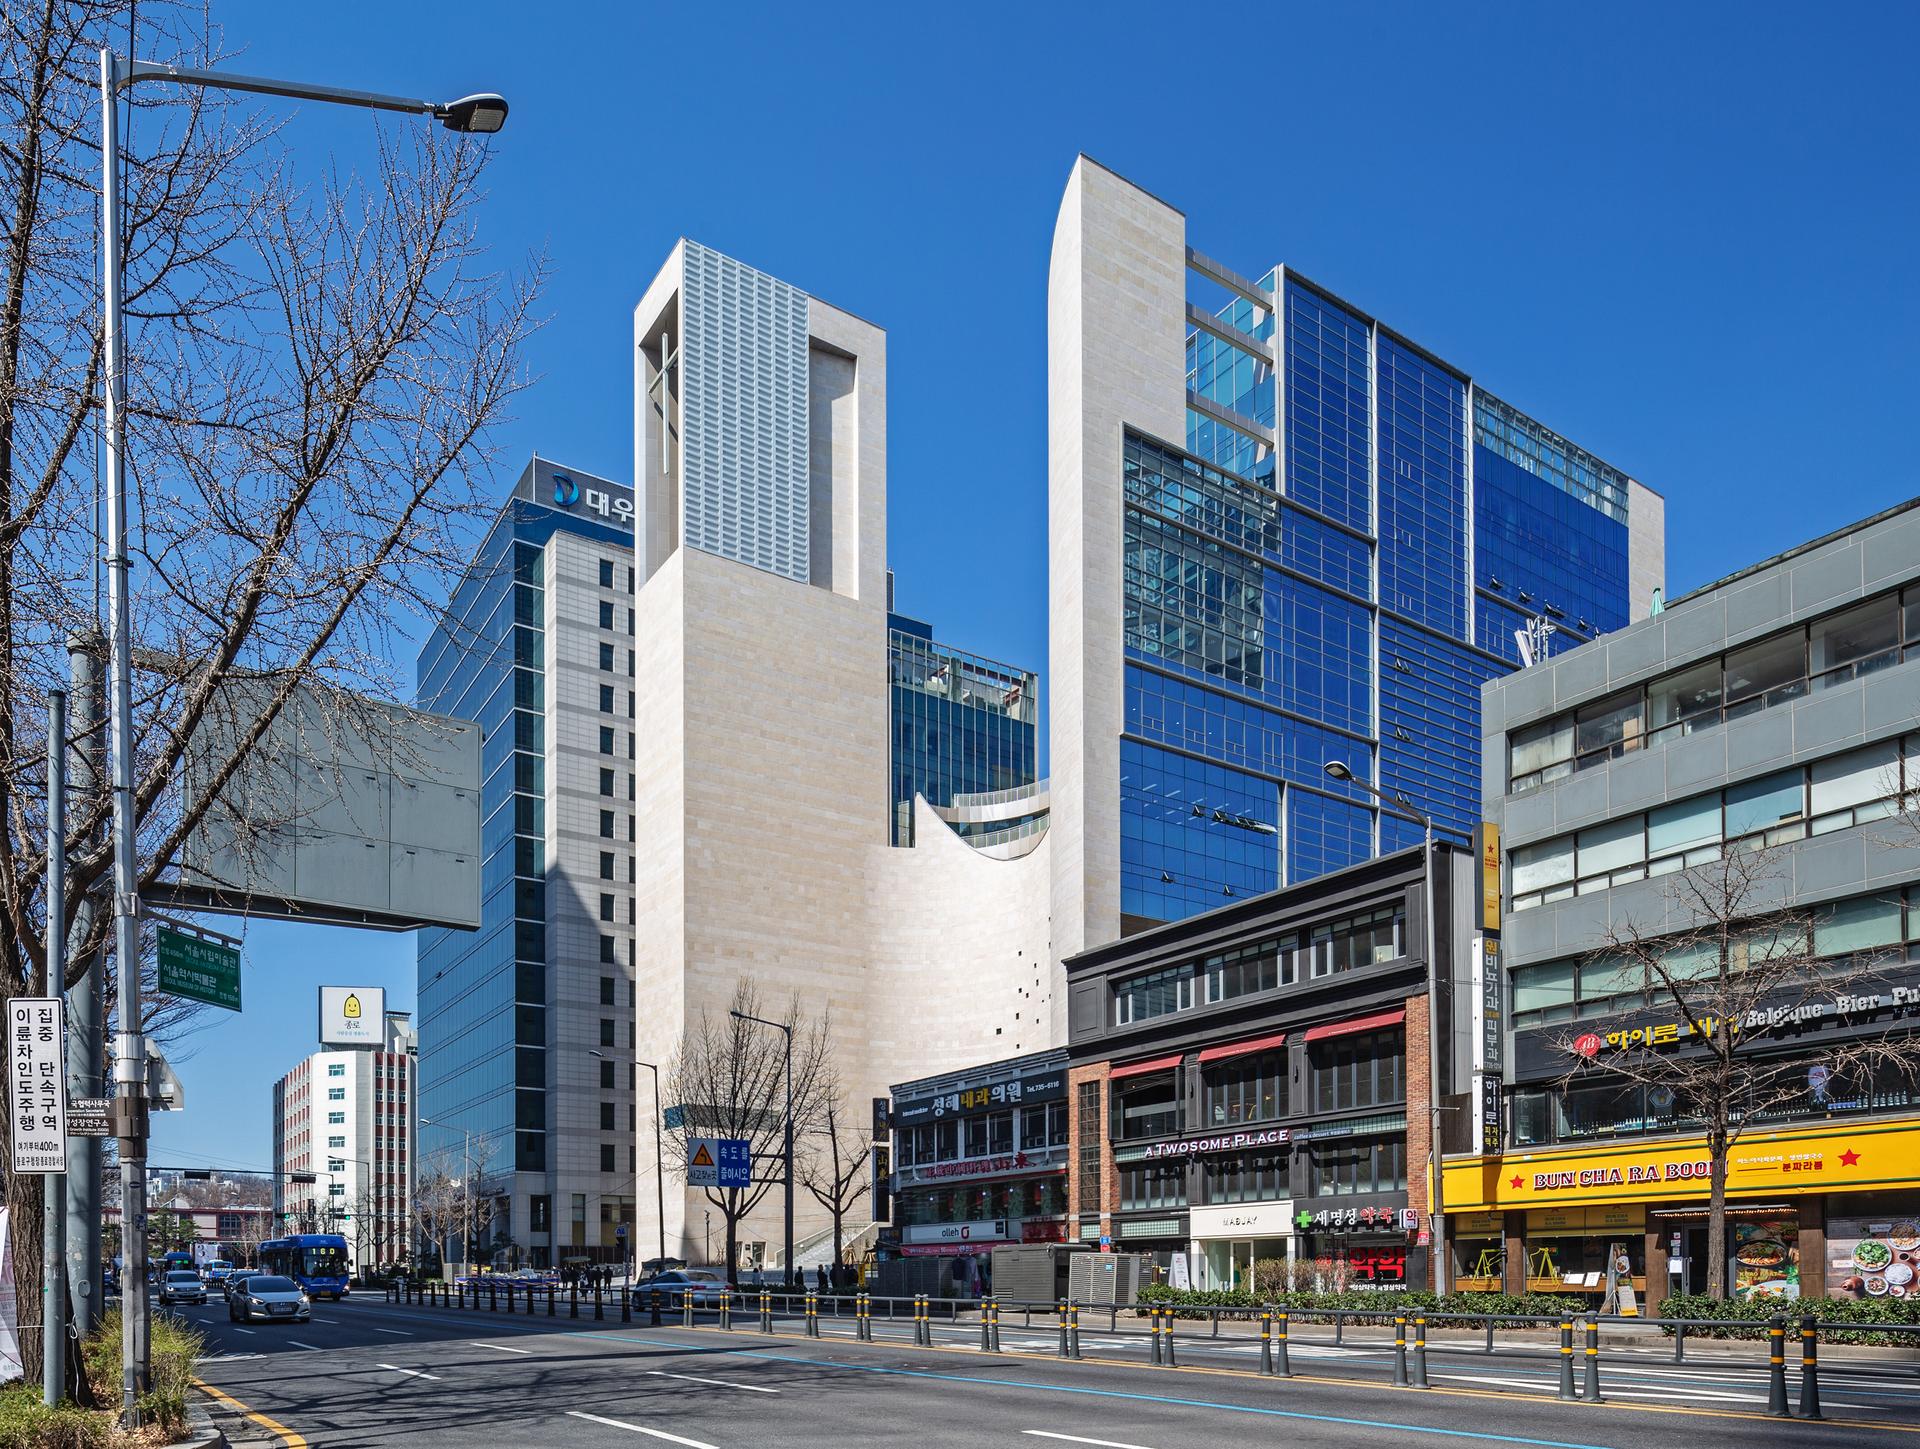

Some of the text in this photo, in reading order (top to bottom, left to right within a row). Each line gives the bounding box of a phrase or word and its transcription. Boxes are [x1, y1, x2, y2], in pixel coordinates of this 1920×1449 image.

[586, 488, 636, 522] 대우
[184, 944, 236, 969] 서울시립미술관
[163, 964, 217, 988] 서울역사박물관
[1836, 994, 1880, 1015] Bier
[1892, 984, 1920, 1006] Pu
[344, 1020, 361, 1030] 종로
[1606, 1023, 1680, 1050] 하이로
[1486, 1020, 1499, 1061] 피부과
[16, 1008, 35, 1132] 이륜차인도주행
[37, 1008, 57, 1131] 집중 단속구역
[1485, 1080, 1498, 1125] 하이로
[1144, 1130, 1289, 1157] A TWOSOME PLACE
[1484, 1126, 1499, 1136] 피자
[1484, 1137, 1499, 1147] 맥주
[720, 1146, 748, 1160] 속도를
[720, 1166, 748, 1180] 줄이시오
[1533, 1171, 1577, 1191] BUN
[1579, 1167, 1624, 1188] CHA
[1628, 1164, 1661, 1184] RA
[1782, 1161, 1823, 1172] 분짜라붐
[1406, 1210, 1417, 1224] 약
[941, 1228, 959, 1238] olleh
